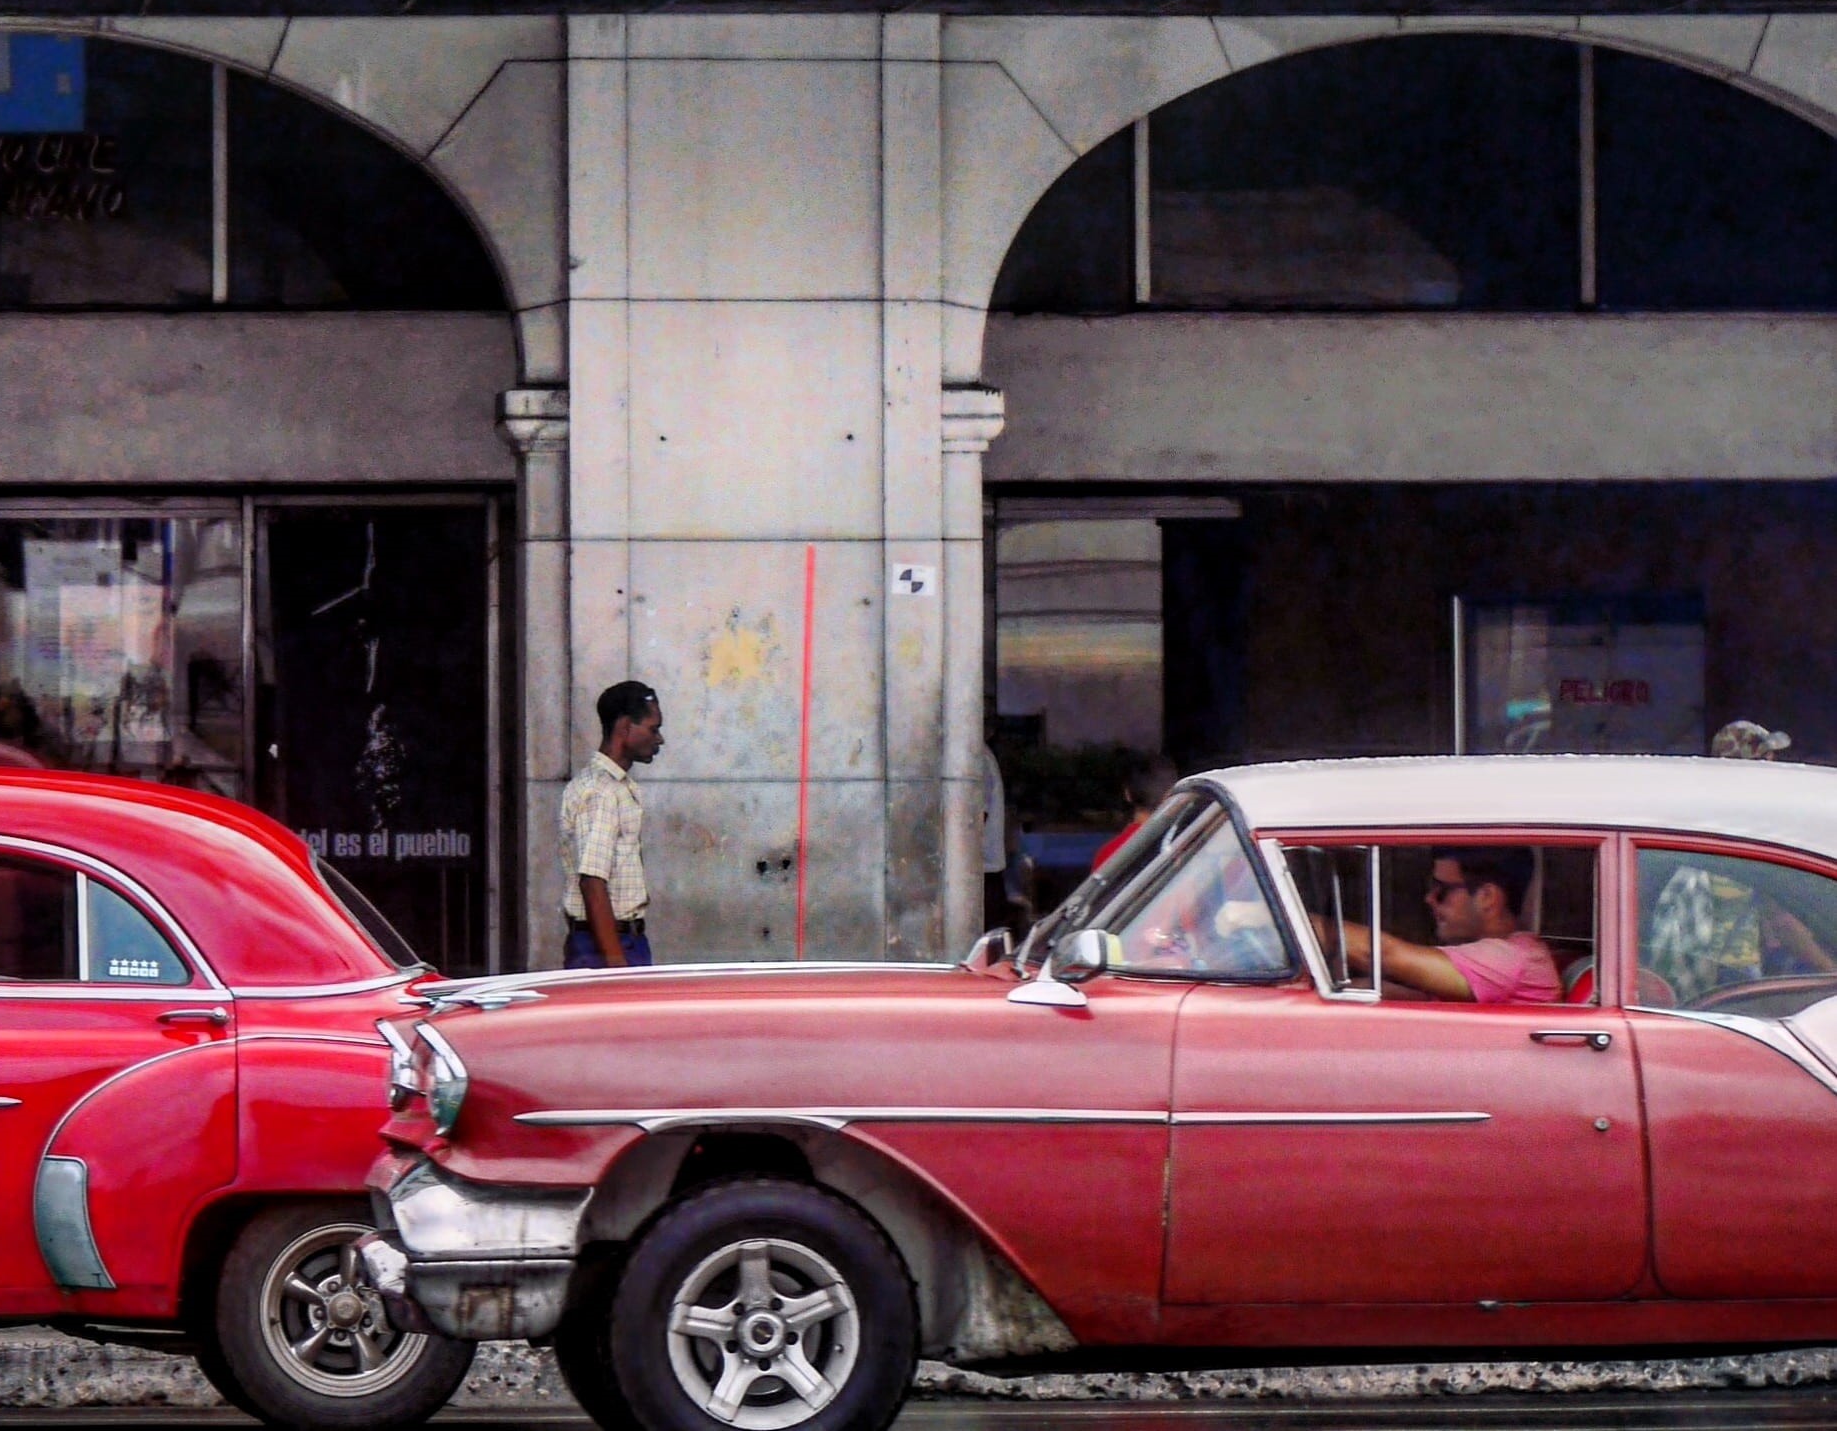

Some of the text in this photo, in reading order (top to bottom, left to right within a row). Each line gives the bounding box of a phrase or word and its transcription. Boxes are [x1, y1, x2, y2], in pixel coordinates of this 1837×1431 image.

[335, 834, 362, 856] es
[369, 829, 389, 856] el
[396, 829, 470, 861] pueblo
